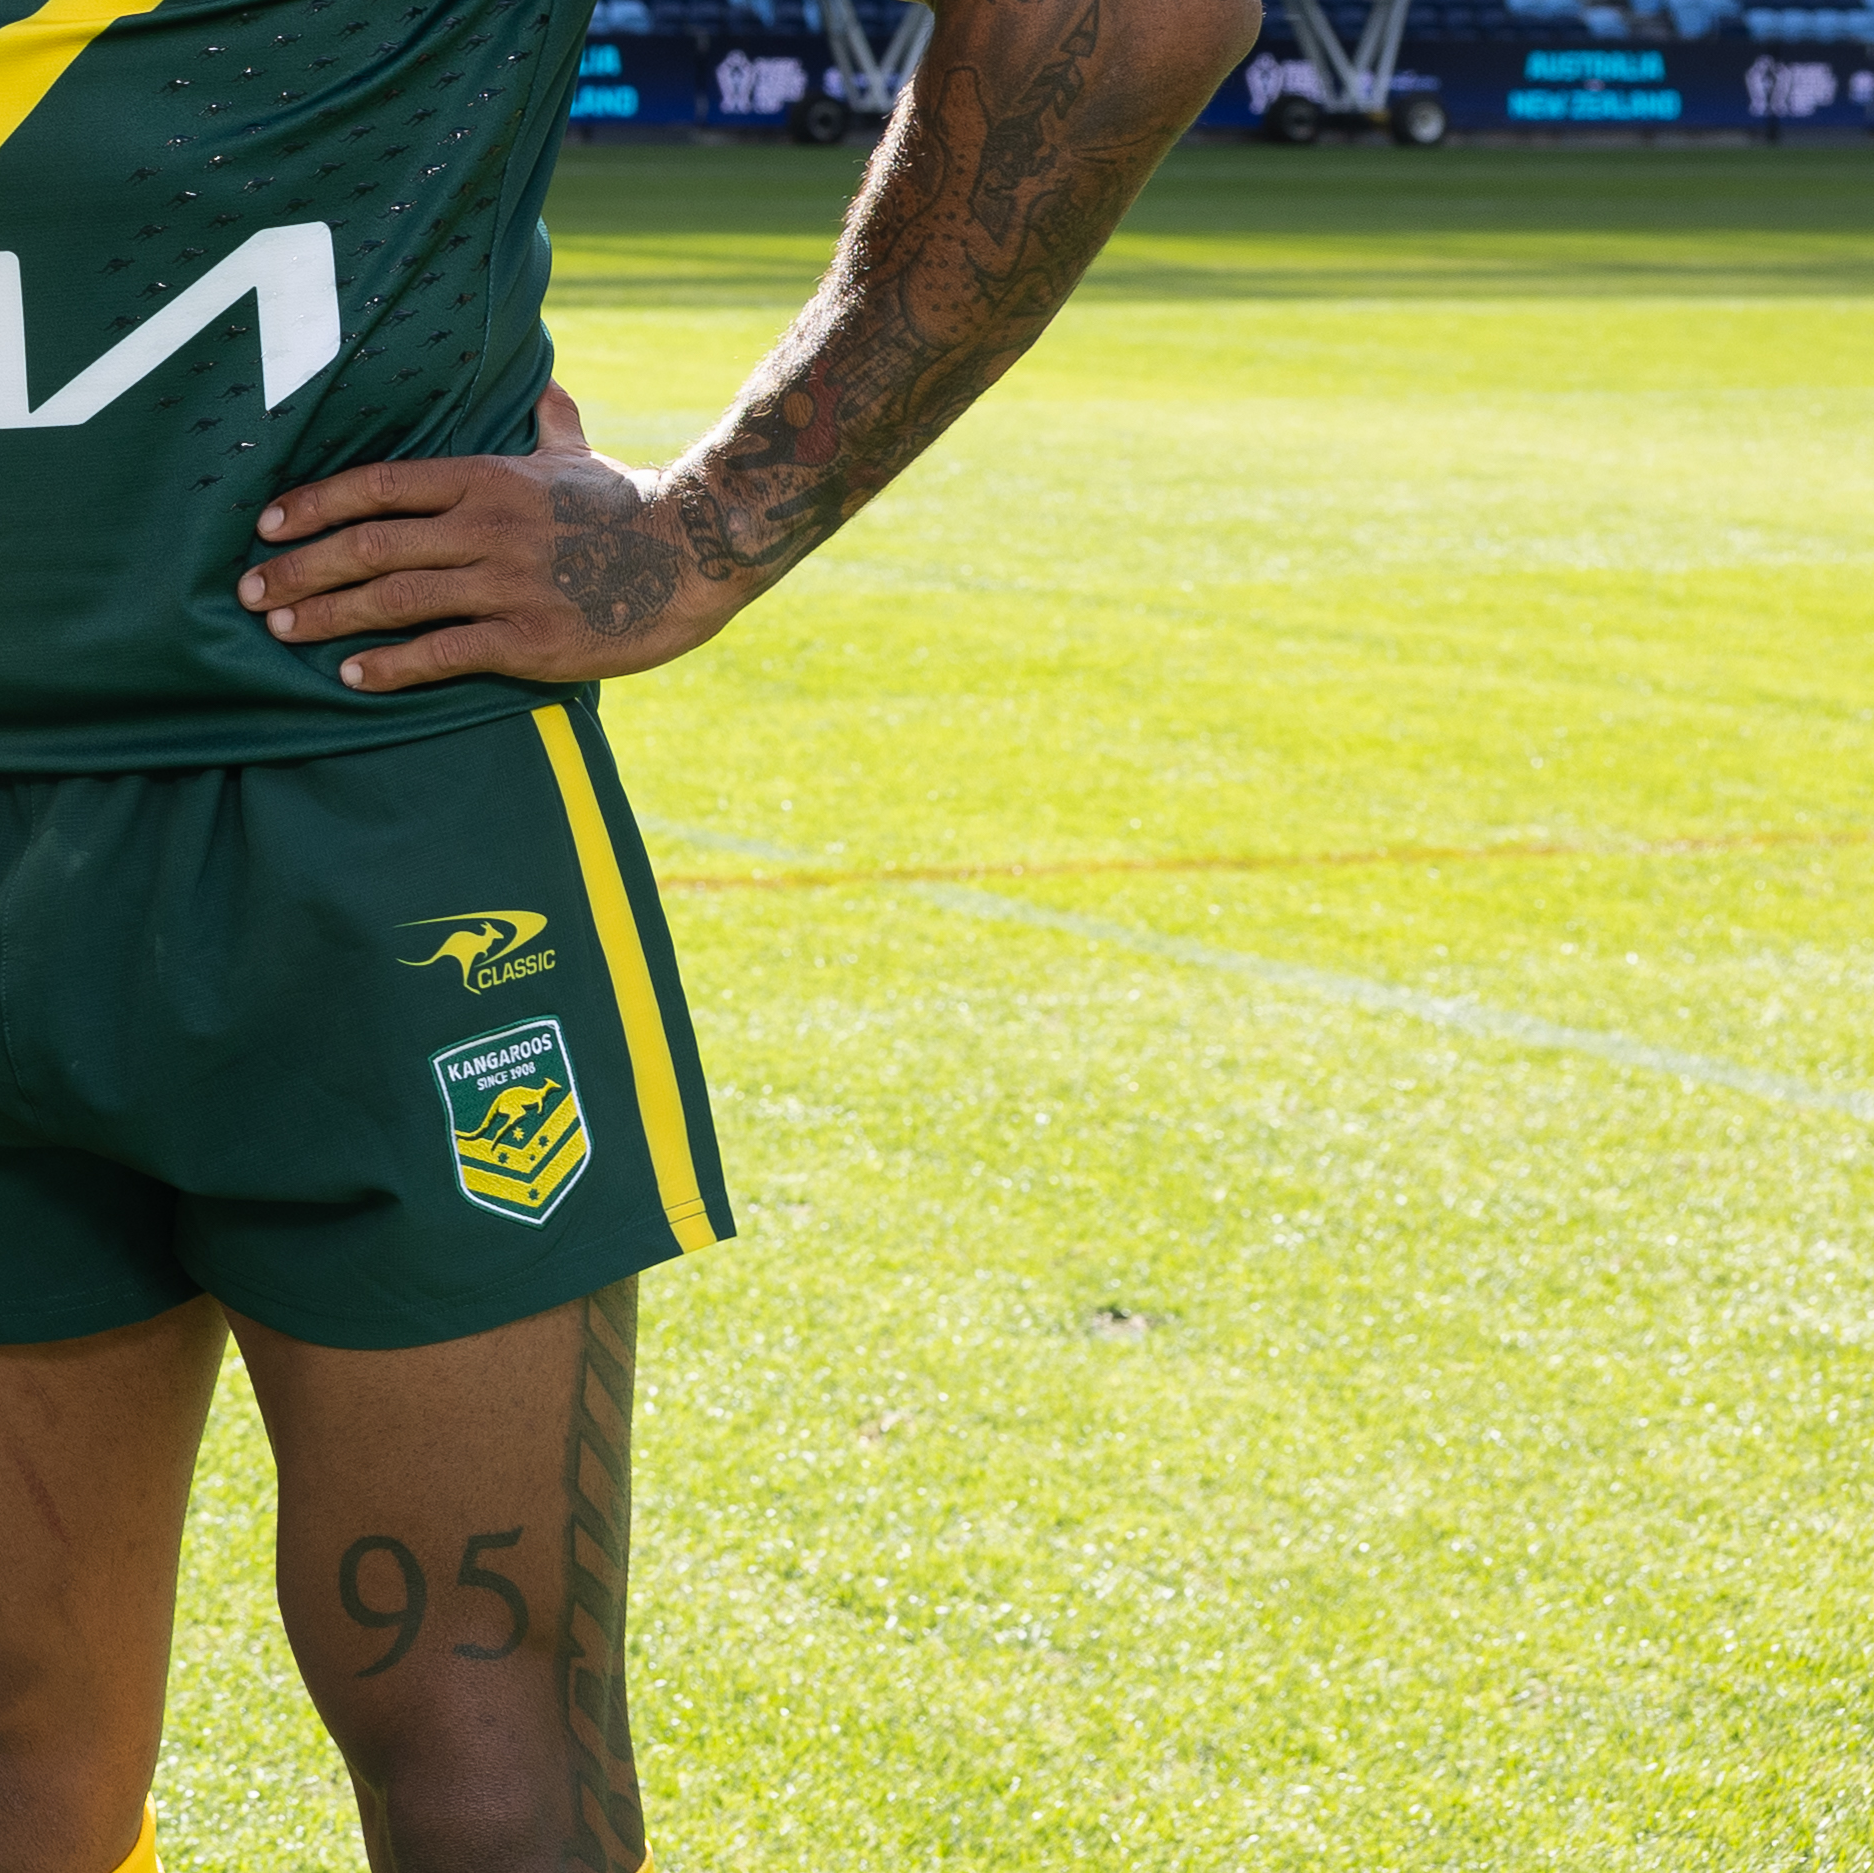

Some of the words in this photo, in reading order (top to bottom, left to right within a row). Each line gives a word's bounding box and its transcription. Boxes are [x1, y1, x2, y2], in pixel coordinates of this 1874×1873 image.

[477, 949, 556, 989] CLASSIC
[447, 1033, 553, 1082] KANGAROOS
[476, 1070, 508, 1091] SINCE
[508, 1061, 537, 1081] 1908
[338, 1526, 530, 1678] 95
